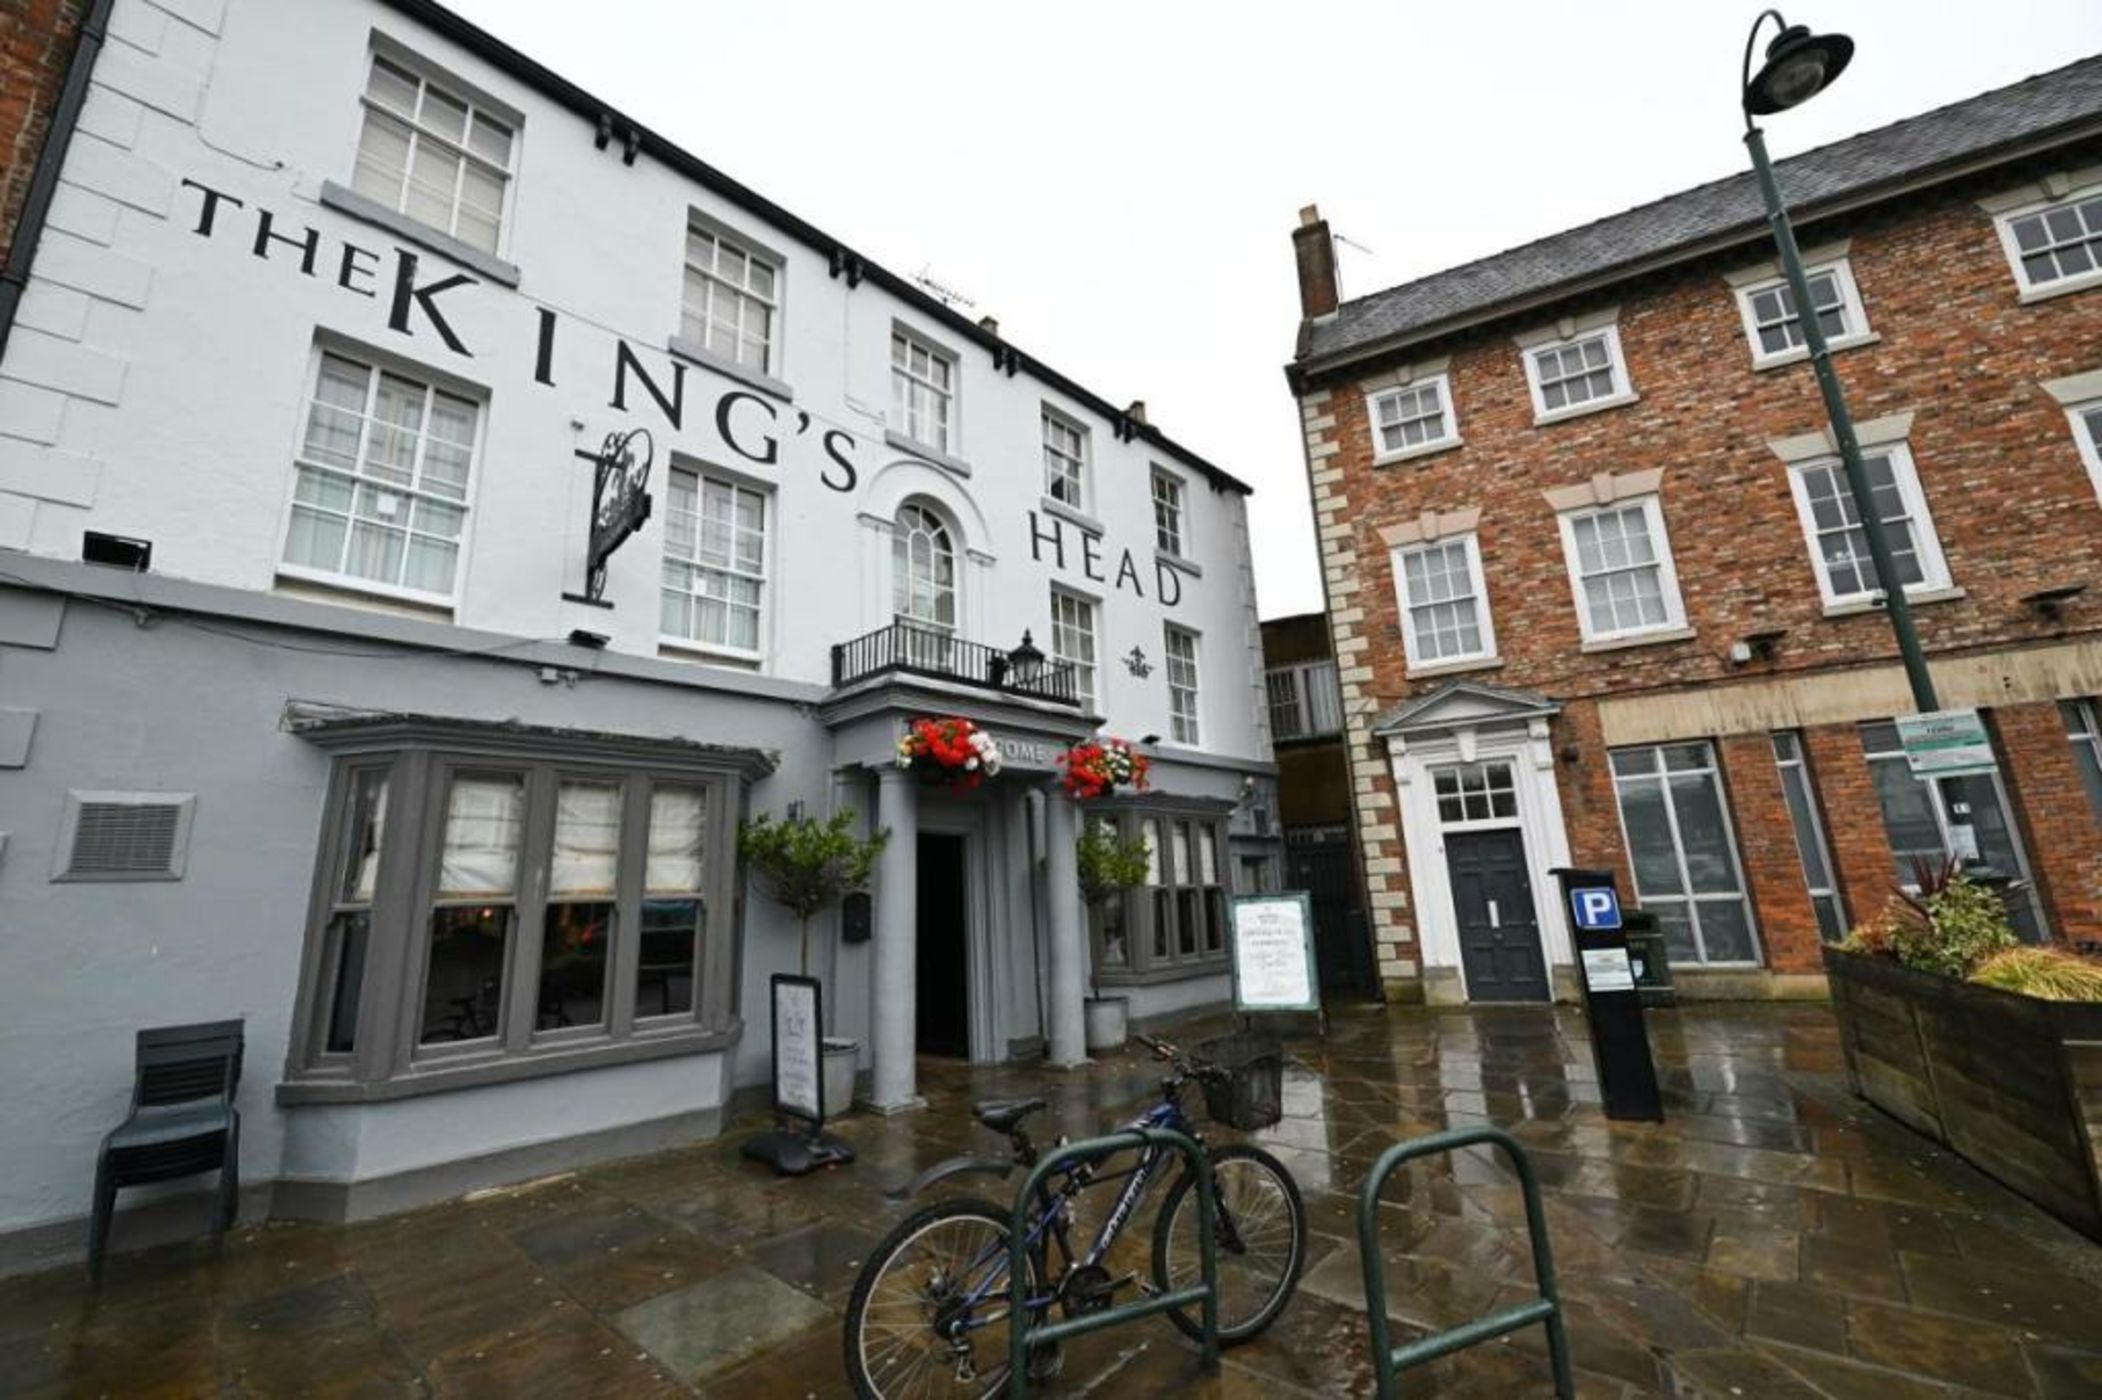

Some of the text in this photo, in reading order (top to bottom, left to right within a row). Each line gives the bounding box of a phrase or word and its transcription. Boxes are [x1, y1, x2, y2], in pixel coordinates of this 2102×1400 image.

[181, 178, 1182, 607] THE KING'S HEAD
[1583, 892, 1611, 925] P
